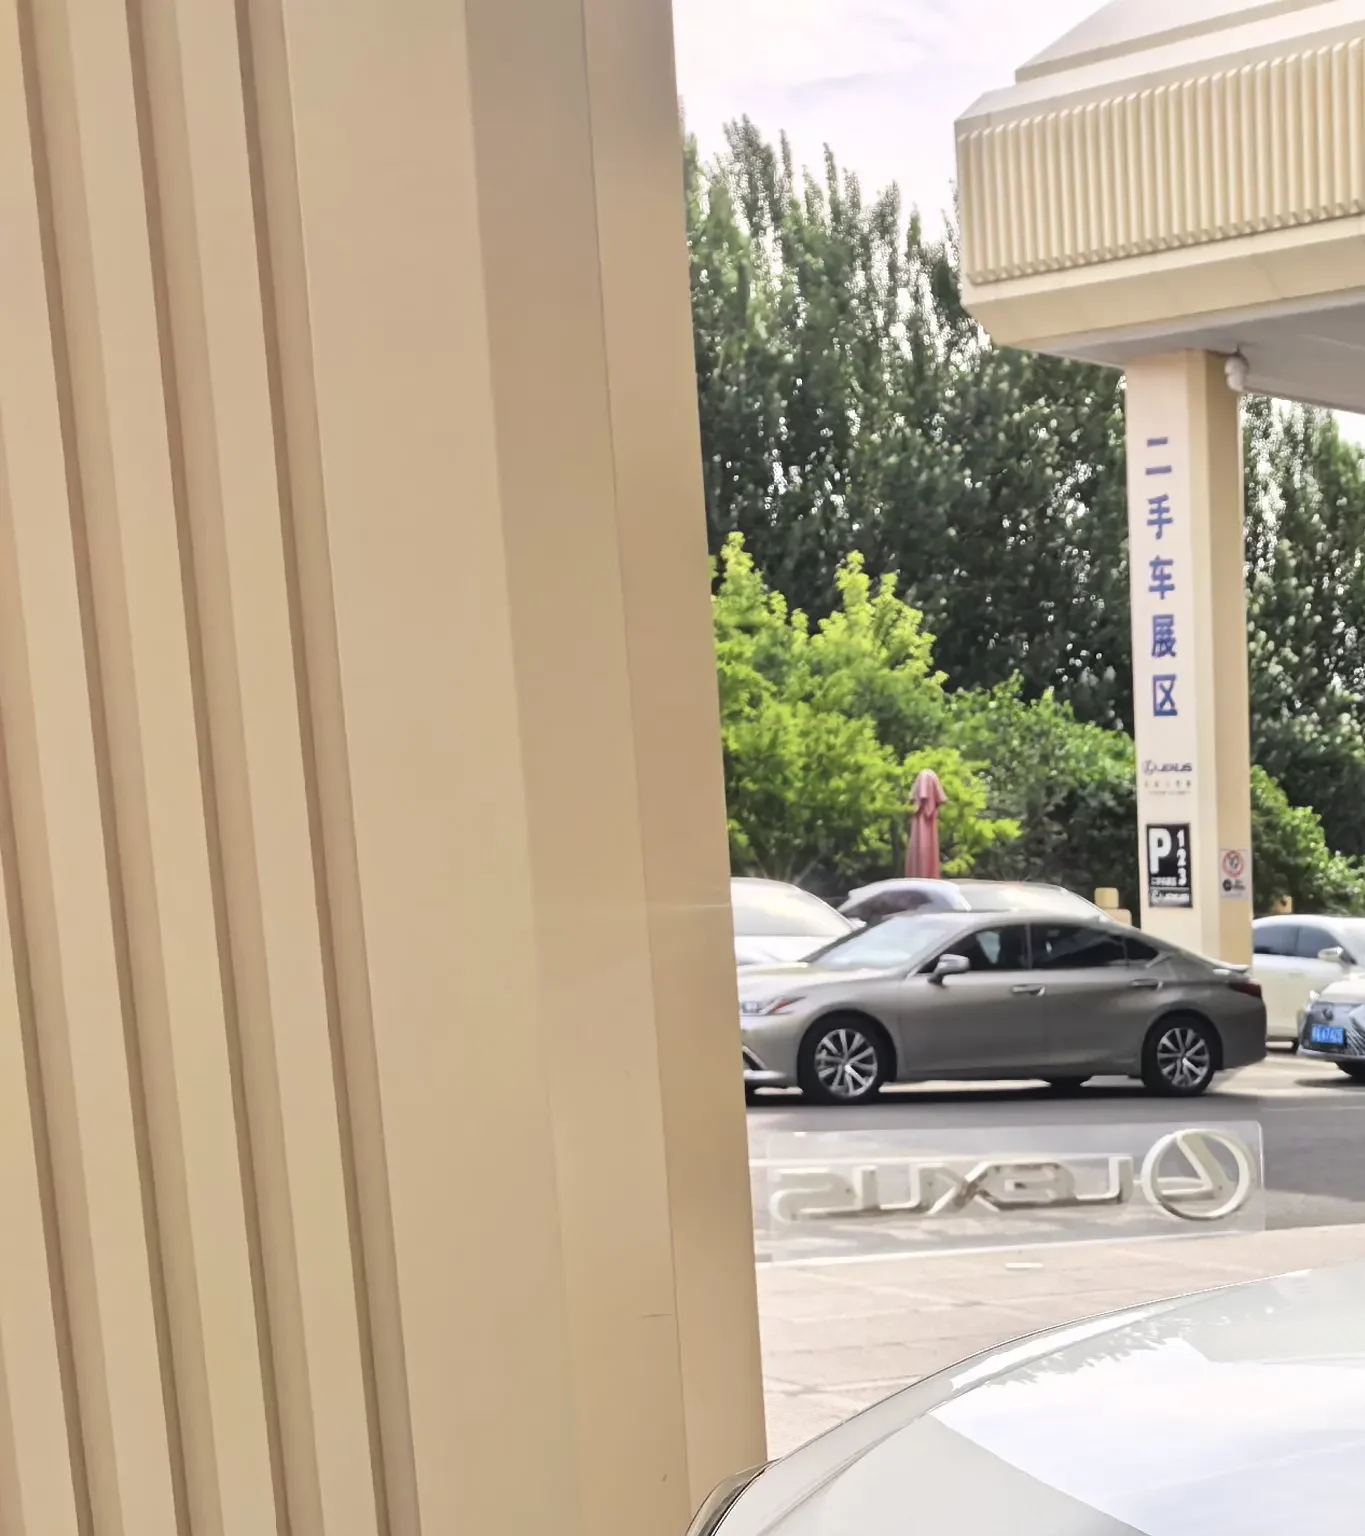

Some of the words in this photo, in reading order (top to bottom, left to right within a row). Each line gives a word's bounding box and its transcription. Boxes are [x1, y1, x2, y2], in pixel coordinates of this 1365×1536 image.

[1145, 437, 1178, 717] 二手车展区
[1149, 828, 1172, 874] P
